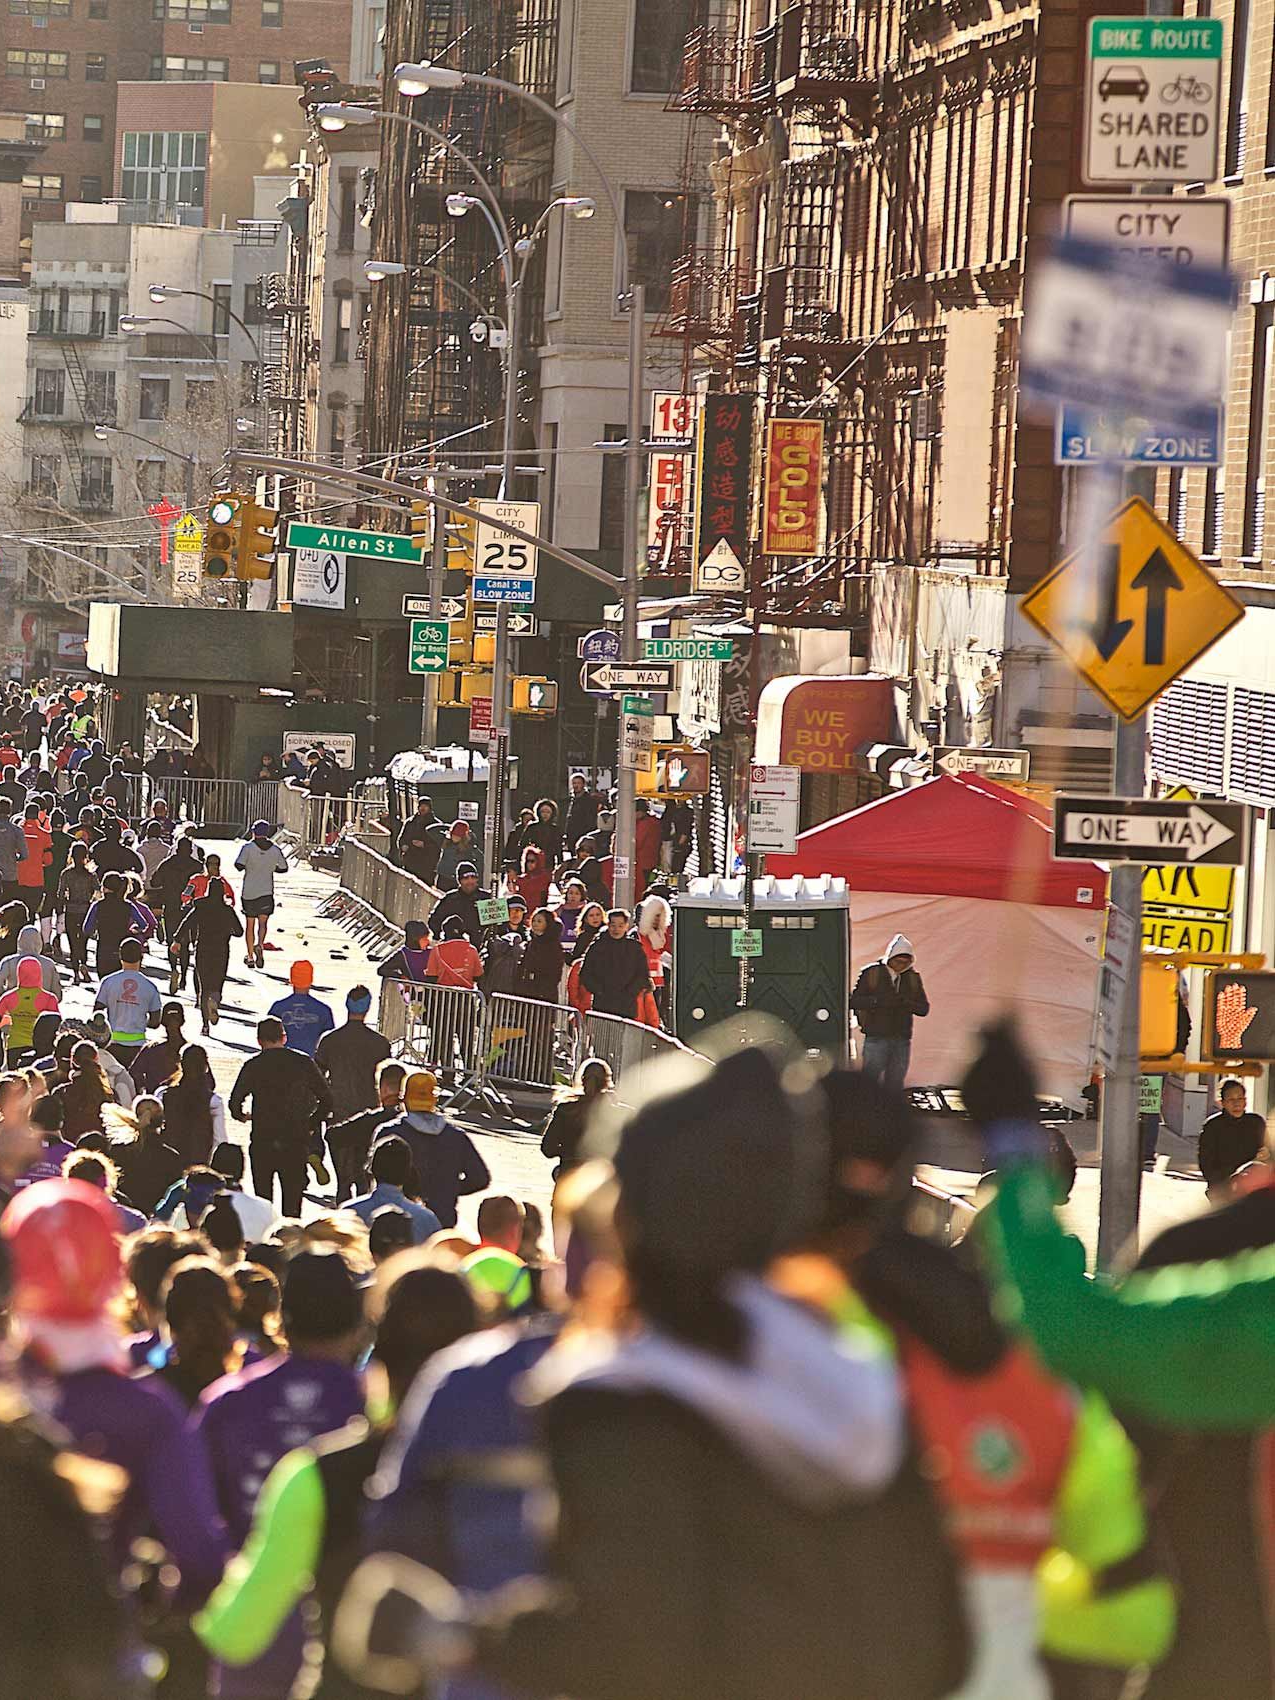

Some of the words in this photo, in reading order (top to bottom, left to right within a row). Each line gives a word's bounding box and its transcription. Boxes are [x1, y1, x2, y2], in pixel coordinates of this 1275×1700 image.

[1099, 29, 1143, 50] BIKE
[1151, 29, 1214, 50] ROUTE
[1098, 112, 1210, 137] SHARED
[1114, 144, 1189, 169] LANE
[1116, 213, 1182, 236] CITY
[776, 426, 792, 440] WE
[795, 428, 821, 441] BUY
[1068, 437, 1137, 457] SLW
[1144, 438, 1214, 457] ZONE
[778, 444, 810, 529] GOLD
[496, 508, 521, 517] CITY
[317, 533, 369, 551] Allen
[374, 539, 395, 554] St
[483, 543, 528, 570] 25
[177, 571, 198, 582] 25
[703, 566, 741, 582] DG
[486, 579, 511, 589] Canal
[513, 580, 521, 589] St
[476, 590, 502, 599] SLOW
[505, 591, 531, 600] ZONE
[412, 602, 431, 610] ONE
[481, 618, 497, 626] ONE
[412, 644, 427, 652] Bike
[428, 645, 447, 653] Route
[644, 641, 716, 658] ELDRIDGE
[717, 642, 729, 651] ST
[599, 672, 624, 682] ONE
[636, 672, 663, 683] WAY
[804, 709, 846, 728] WE
[625, 738, 651, 749] SHARED
[796, 730, 851, 748] BUY
[947, 757, 975, 770] ONE
[986, 758, 1015, 771] WAY
[1080, 818, 1131, 842] ONE
[1157, 821, 1215, 846] WAY
[480, 905, 506, 914] PARKING
[482, 912, 506, 922] SUNDAY
[1142, 924, 1214, 953] HEAD
